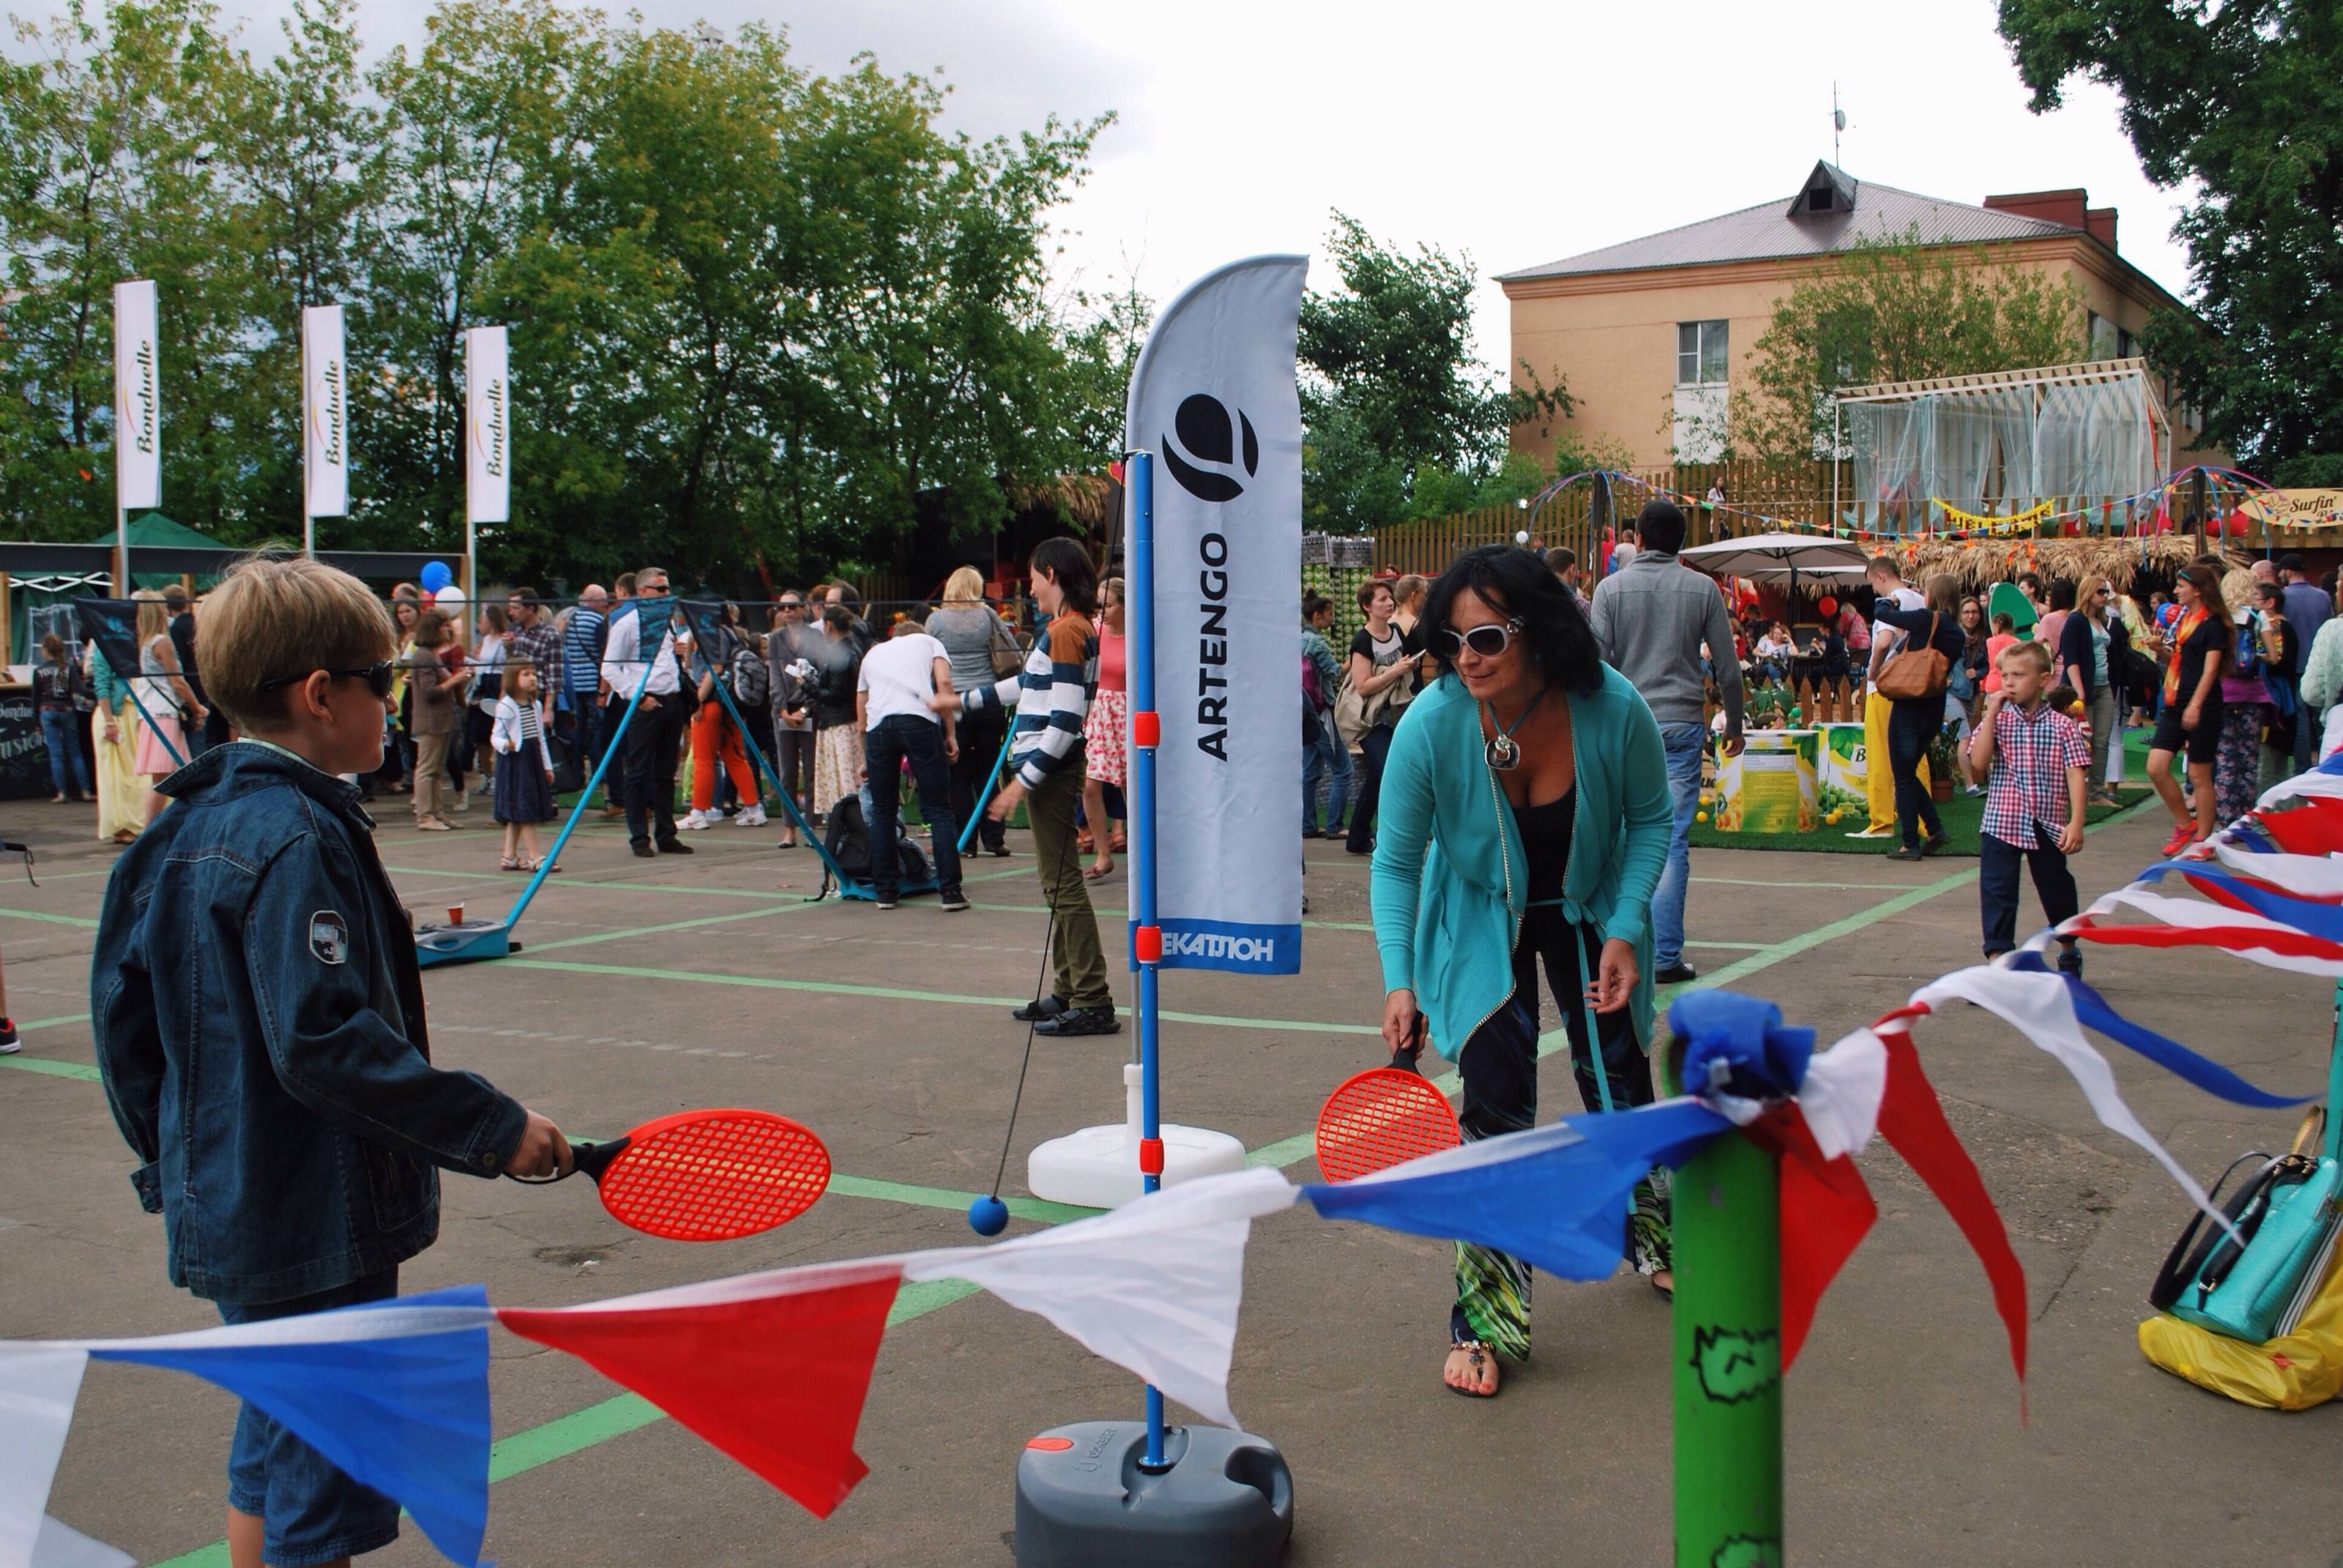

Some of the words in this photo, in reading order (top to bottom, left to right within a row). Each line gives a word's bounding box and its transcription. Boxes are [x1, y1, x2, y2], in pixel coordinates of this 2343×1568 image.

[136, 340, 156, 453] Bonduelle
[325, 360, 343, 465] Bonduelle
[486, 379, 506, 477] Bonduelle
[1197, 532, 1228, 762] ARTENGO
[1161, 932, 1274, 962] ЕКАТЛОН
